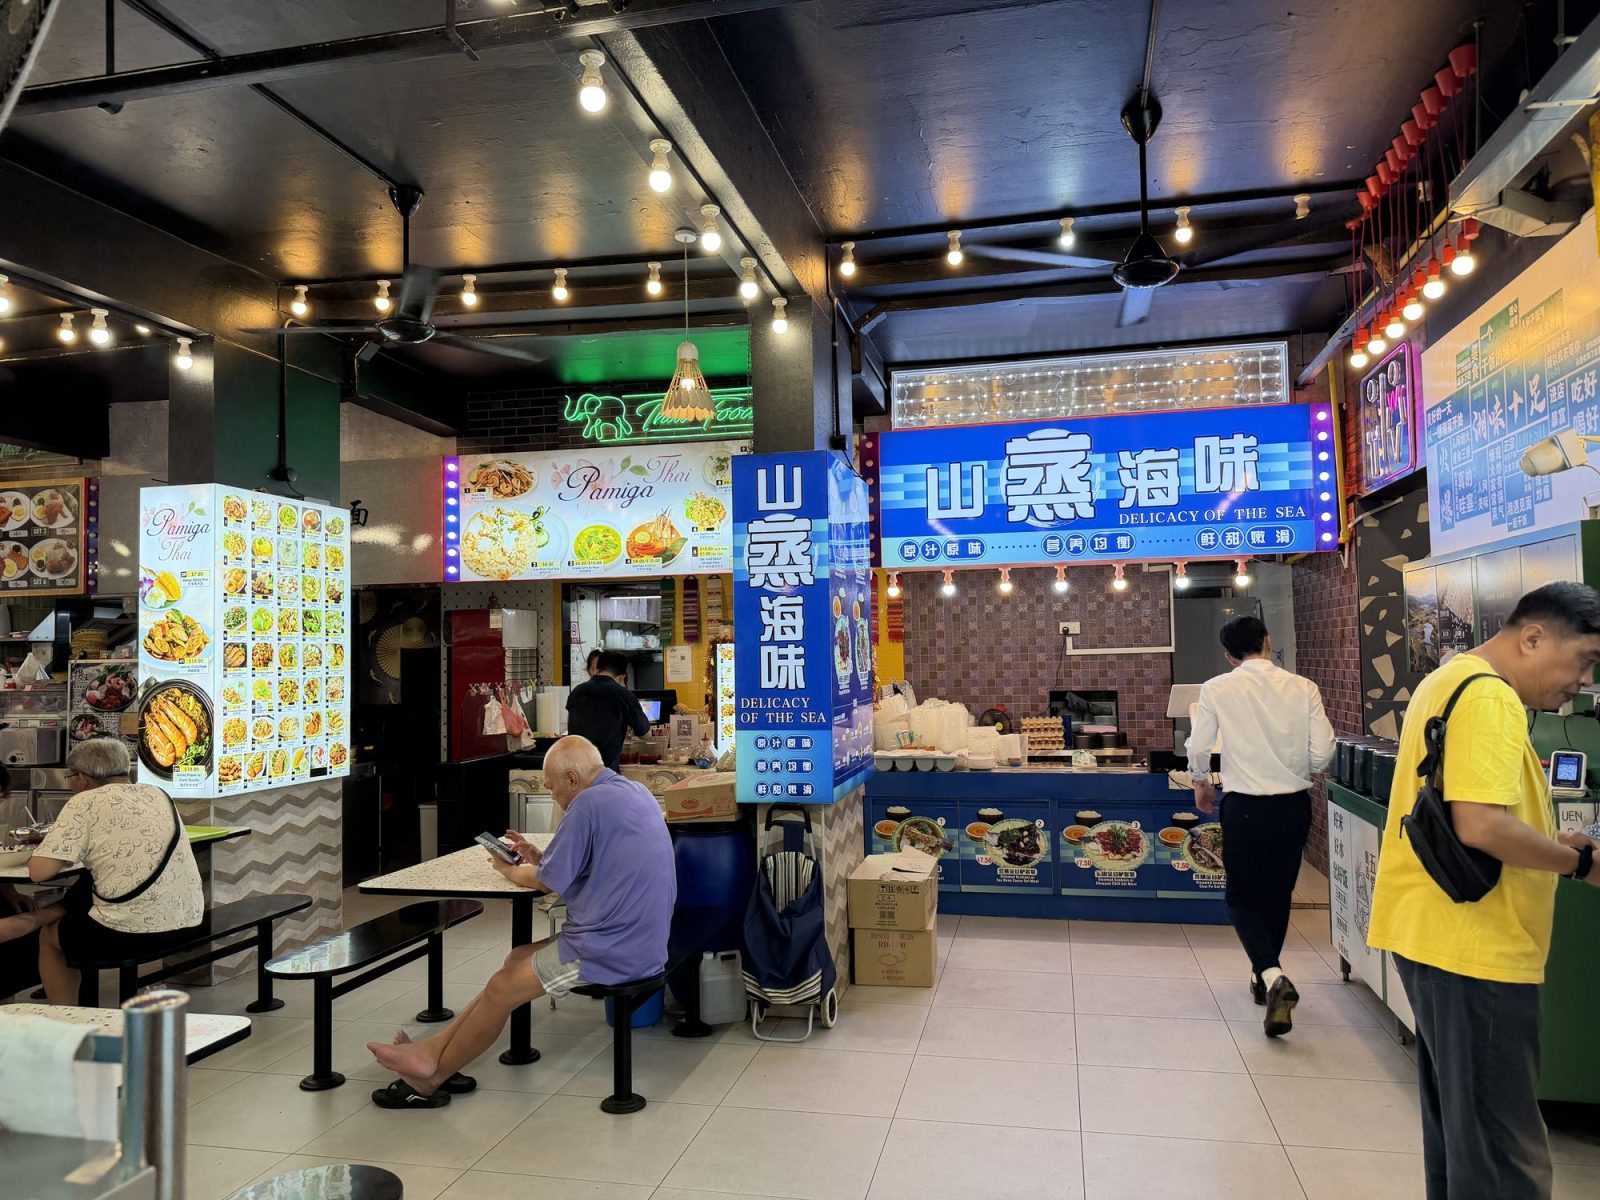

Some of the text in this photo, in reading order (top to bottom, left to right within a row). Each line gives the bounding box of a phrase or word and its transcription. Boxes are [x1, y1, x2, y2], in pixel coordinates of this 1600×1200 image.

[1571, 369, 1597, 403] 吃好
[1472, 372, 1546, 443] 湘味十足
[1573, 405, 1600, 436] 喝好
[643, 454, 692, 483] Thai
[925, 430, 1261, 523] 山蒸海味
[1458, 467, 1473, 490] 真的
[558, 465, 657, 509] Pamiga
[146, 508, 211, 542] Pamiga
[1119, 506, 1306, 525] DELICACY OF THE SEA
[1046, 535, 1131, 552] 营养均衡
[1200, 529, 1290, 546] 鲜甜嫩滑
[158, 539, 193, 561] Thai
[902, 542, 982, 558] 原汁原味
[747, 463, 814, 690] 山蒸海味
[740, 697, 810, 709] DELICACY
[740, 711, 827, 723] OF THE SEA
[1333, 809, 1344, 833] 好米
[1333, 836, 1345, 859] 好水
